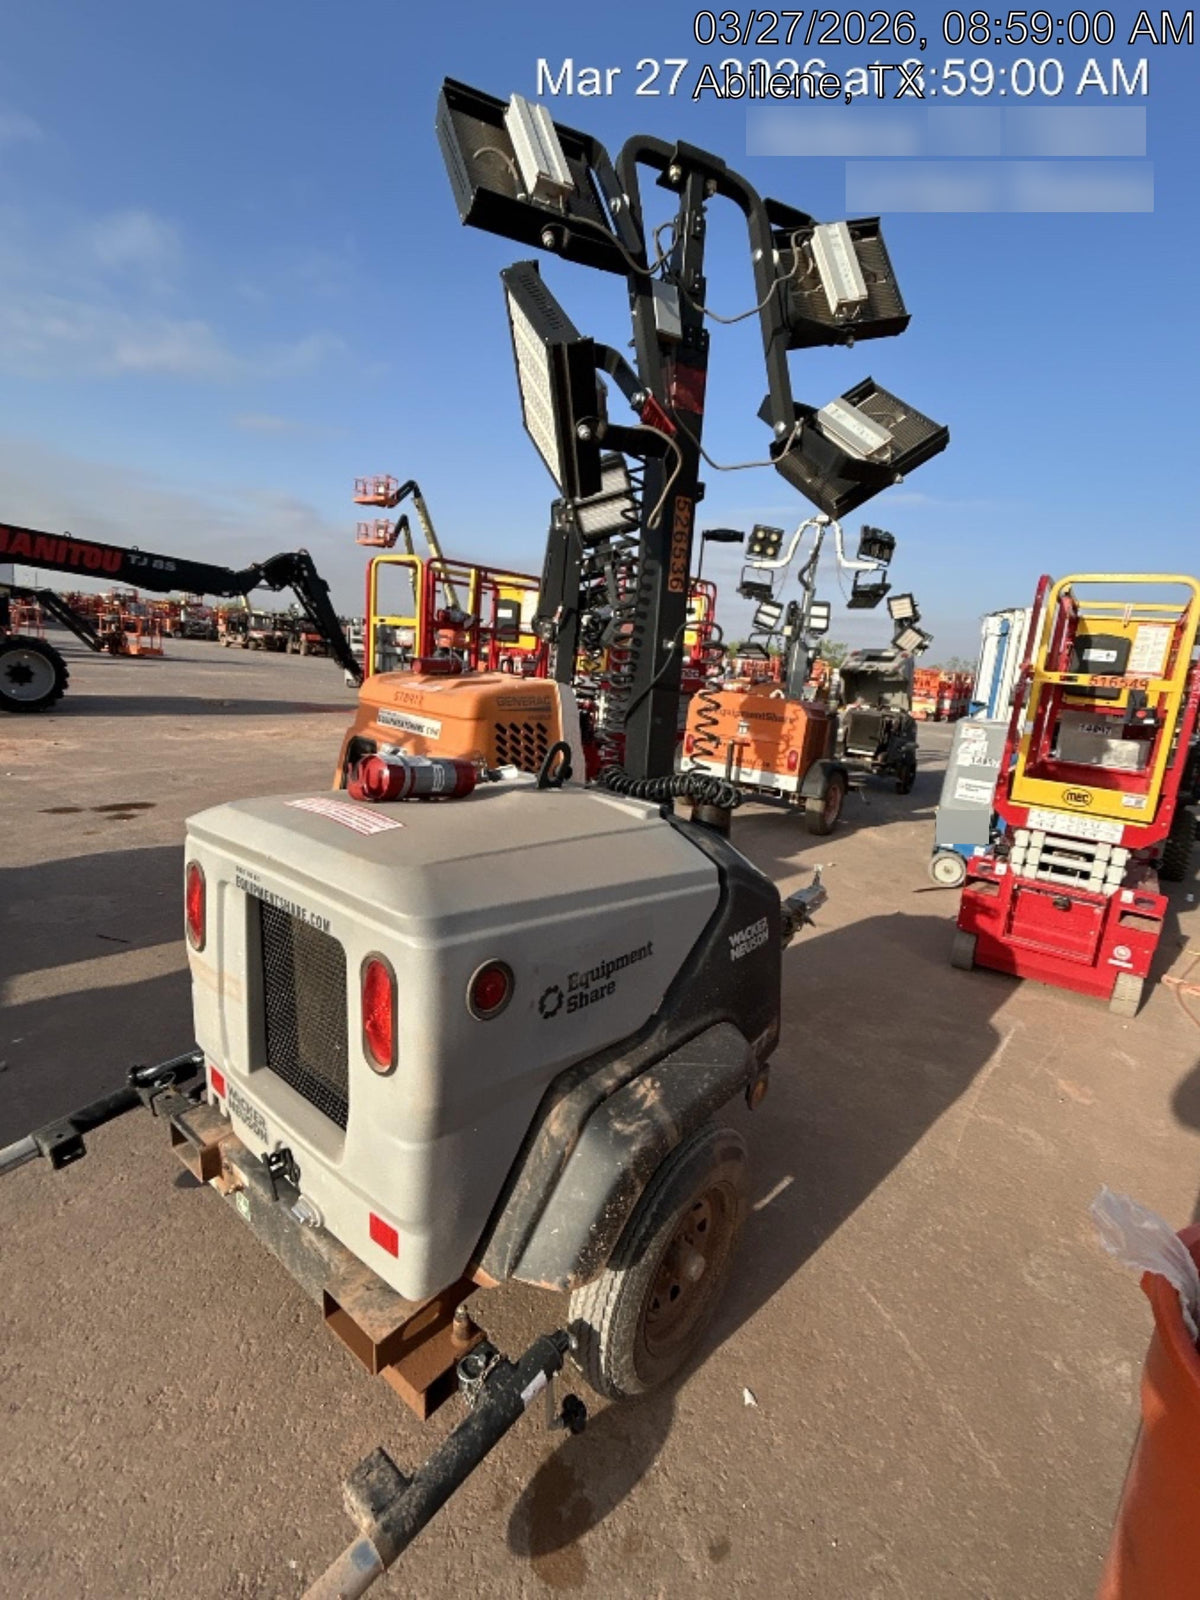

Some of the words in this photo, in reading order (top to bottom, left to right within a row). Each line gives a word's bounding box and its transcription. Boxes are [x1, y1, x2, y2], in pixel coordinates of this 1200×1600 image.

[669, 498, 692, 591] 526536
[728, 916, 768, 948] WACKER
[567, 941, 654, 993] Equipment
[566, 980, 617, 1015] Share
